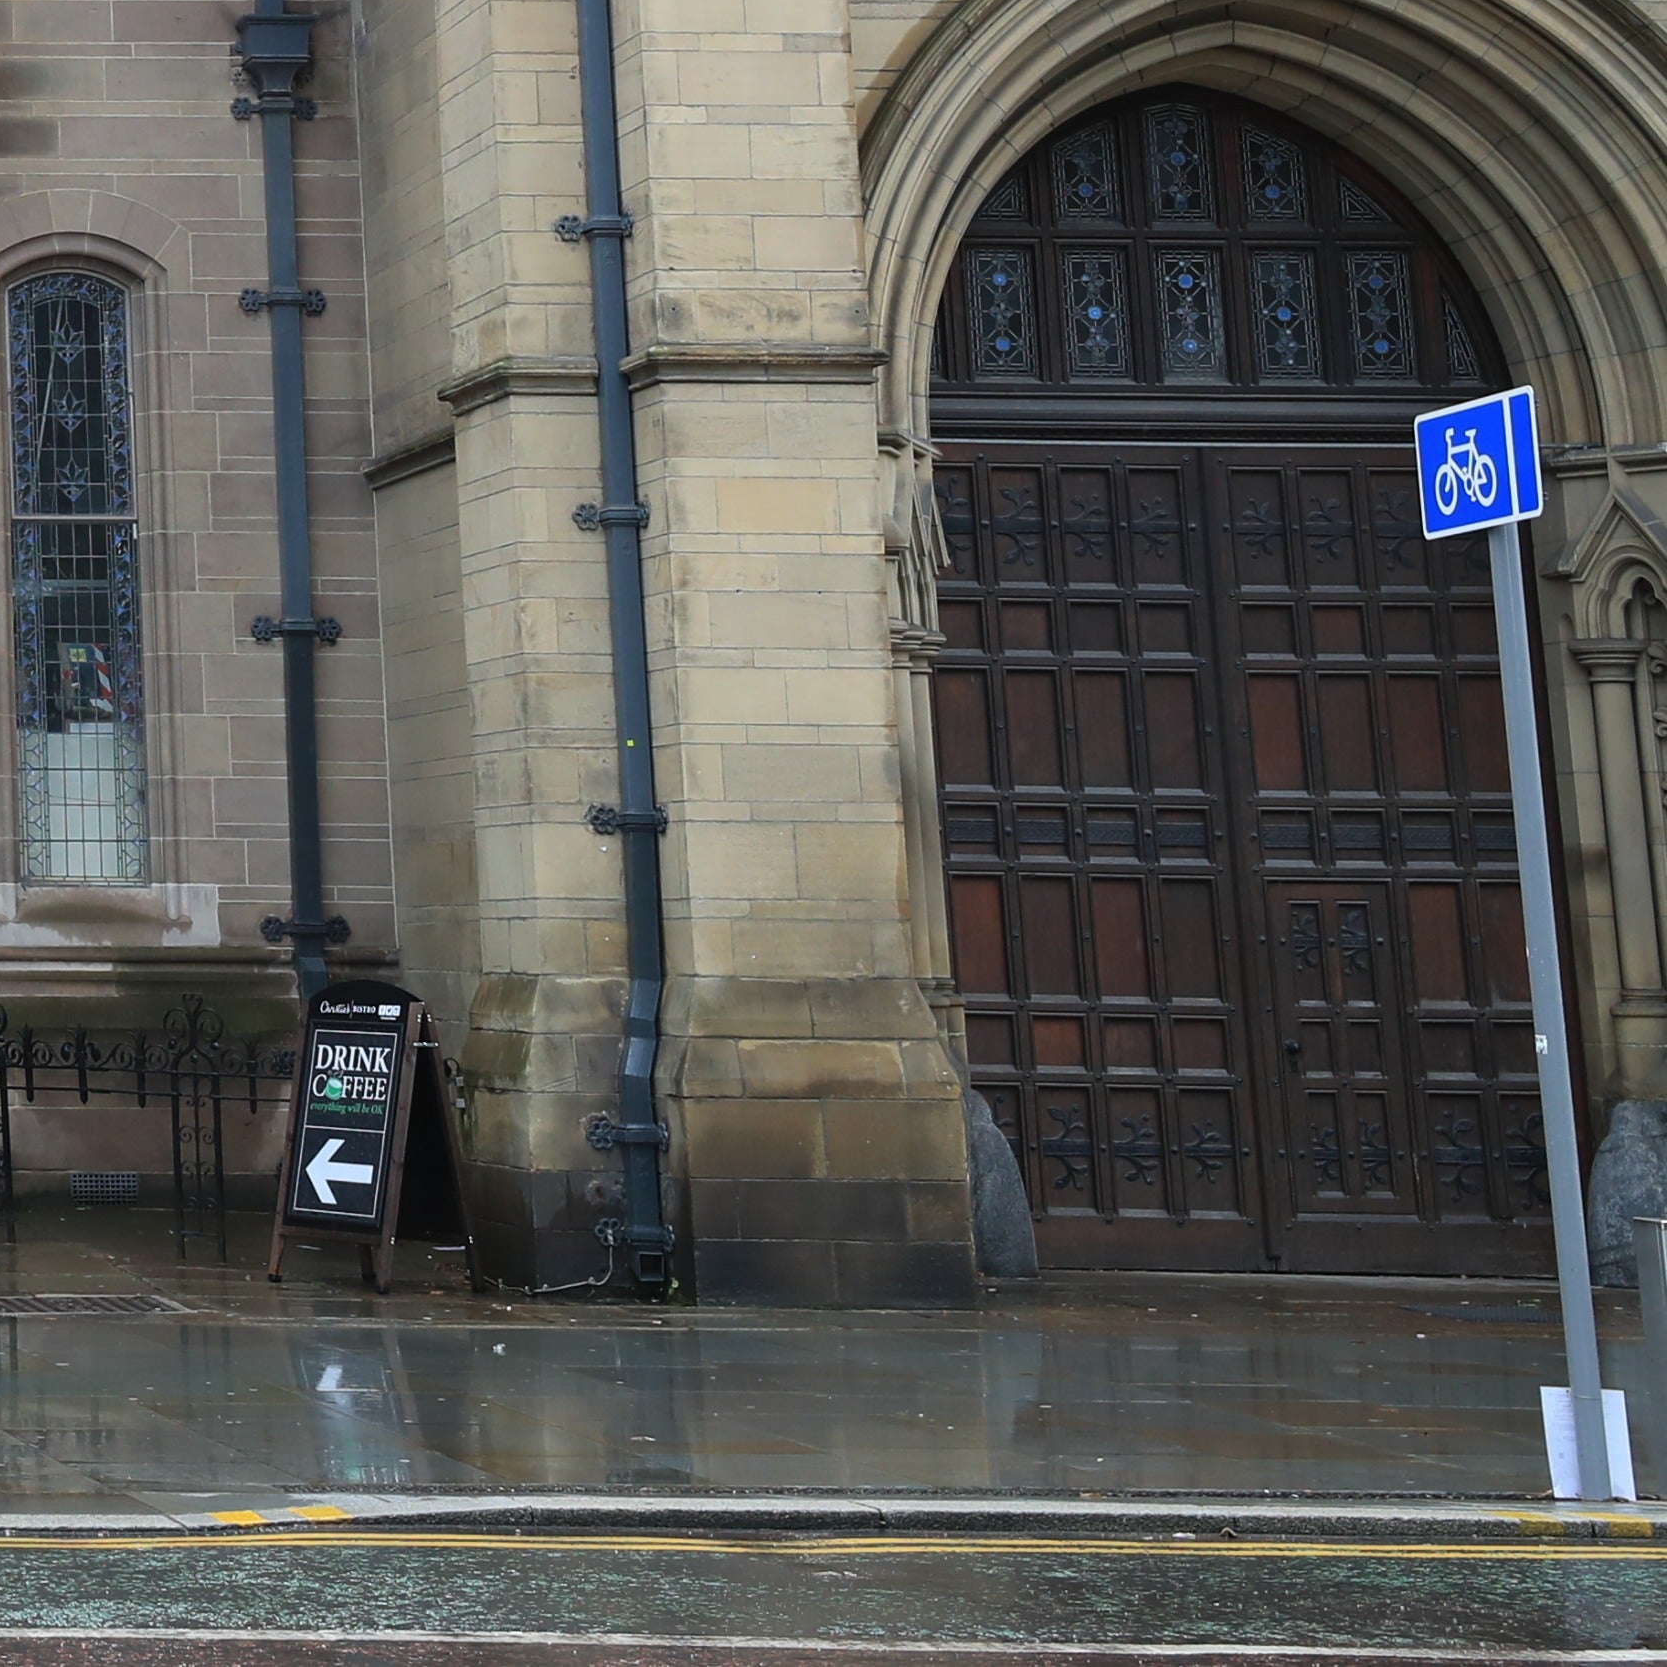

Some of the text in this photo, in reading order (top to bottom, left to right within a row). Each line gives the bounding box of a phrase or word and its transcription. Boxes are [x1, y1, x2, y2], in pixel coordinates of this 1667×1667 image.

[352, 1005, 376, 1014] BISTRO
[315, 1044, 391, 1073] DRINK
[310, 1102, 384, 1115] everything will be OK
